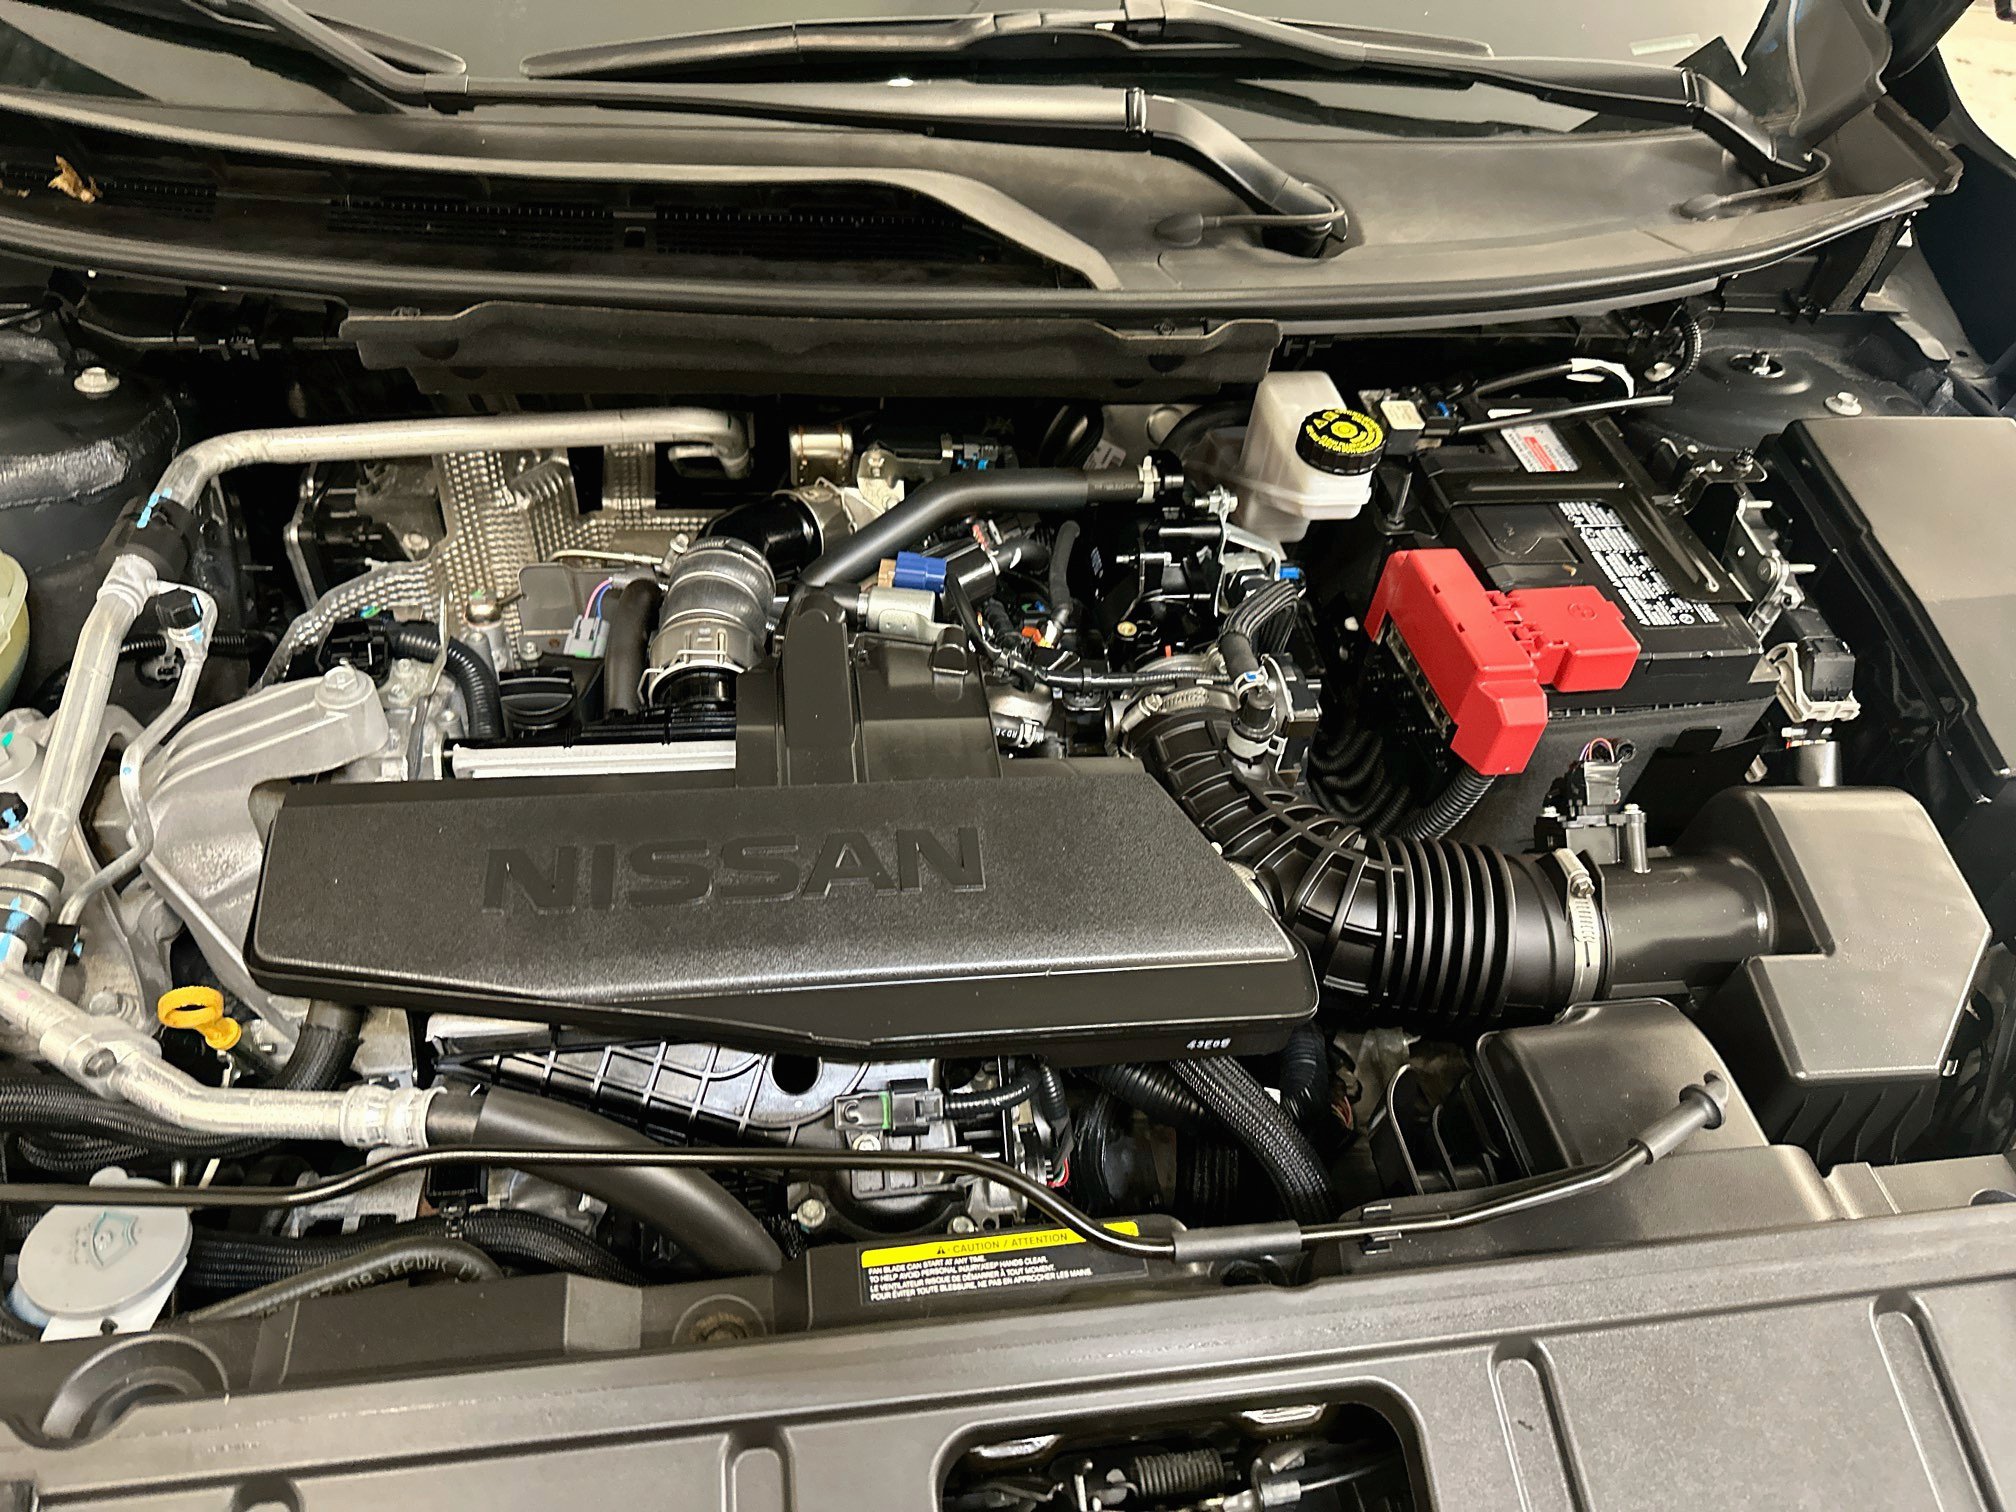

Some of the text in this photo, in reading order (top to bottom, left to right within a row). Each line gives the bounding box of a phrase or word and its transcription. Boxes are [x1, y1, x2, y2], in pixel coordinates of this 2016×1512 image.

[481, 826, 985, 914] NISSAN
[953, 1240, 1000, 1253] CAUTION
[1012, 1233, 1068, 1247] ATTENTION
[868, 1267, 882, 1275] FAN
[883, 1264, 905, 1273] BLADE
[907, 1262, 922, 1271] CAN
[922, 1259, 944, 1269] START
[945, 1258, 954, 1266] AT
[954, 1256, 968, 1265] ANY
[869, 1275, 880, 1284] TO
[880, 1273, 899, 1282] HELP
[899, 1270, 920, 1281] AVOID
[921, 1266, 957, 1277] PERSONAL
[1000, 1258, 1023, 1268] HANDS
[870, 1284, 879, 1293] LE
[880, 1279, 924, 1291] VENTILATEUR
[924, 1275, 951, 1286] RISQUE
[951, 1274, 961, 1282] DE
[1006, 1266, 1024, 1276] TOUT
[870, 1291, 892, 1301] POUR
[917, 1285, 939, 1295] TOUTE
[978, 1279, 988, 1288] NE
[988, 1277, 1003, 1287] PAS
[1003, 1276, 1013, 1285] EN
[1014, 1272, 1056, 1284] APPROCHER
[1056, 1270, 1069, 1280] LES
